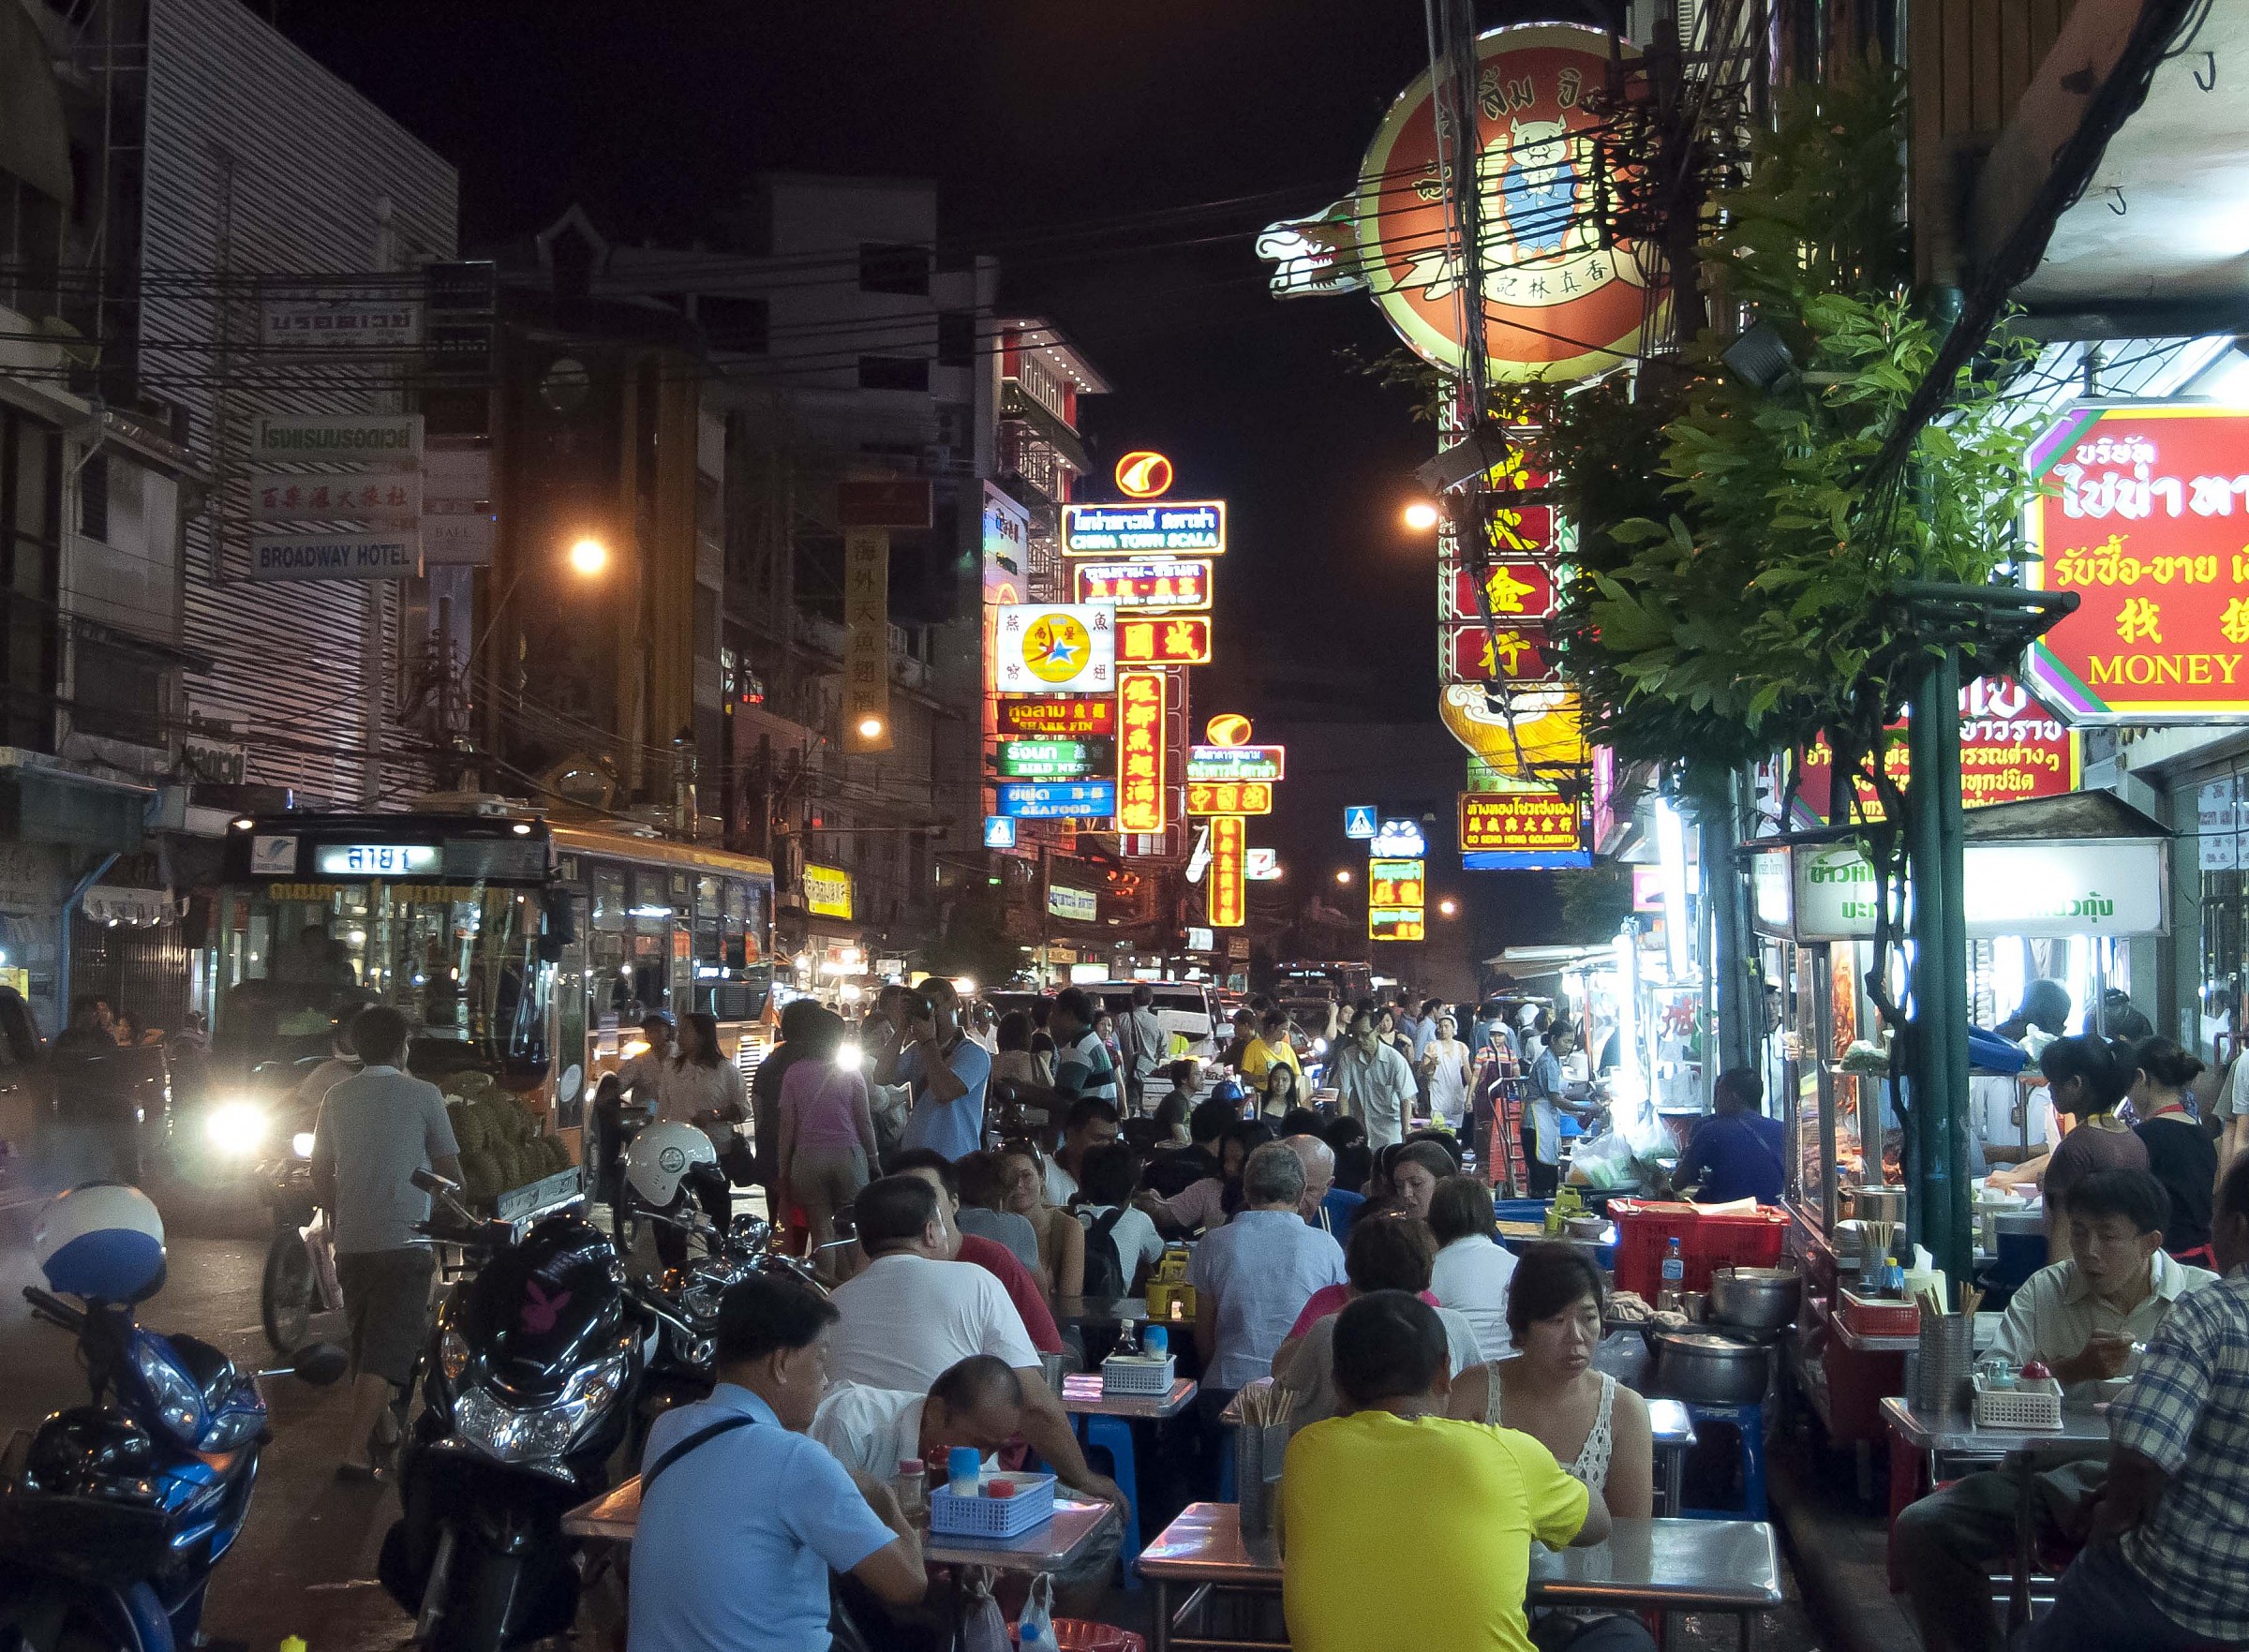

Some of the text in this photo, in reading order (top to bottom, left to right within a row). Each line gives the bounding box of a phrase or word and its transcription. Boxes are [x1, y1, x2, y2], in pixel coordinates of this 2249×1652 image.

[1070, 532, 1217, 549] CHINA TOWN SCALA
[261, 543, 410, 567] BROADWAY HOTEL
[2088, 655, 2242, 685] MONEY
[1020, 722, 1093, 731] SHARK FIN
[1017, 763, 1094, 773] BIRD NEST
[1021, 804, 1091, 815] SEAFOOD
[1467, 835, 1479, 843] SO
[1528, 835, 1574, 843] GOLDSMITH
[1810, 858, 1875, 883] ข้าวห
